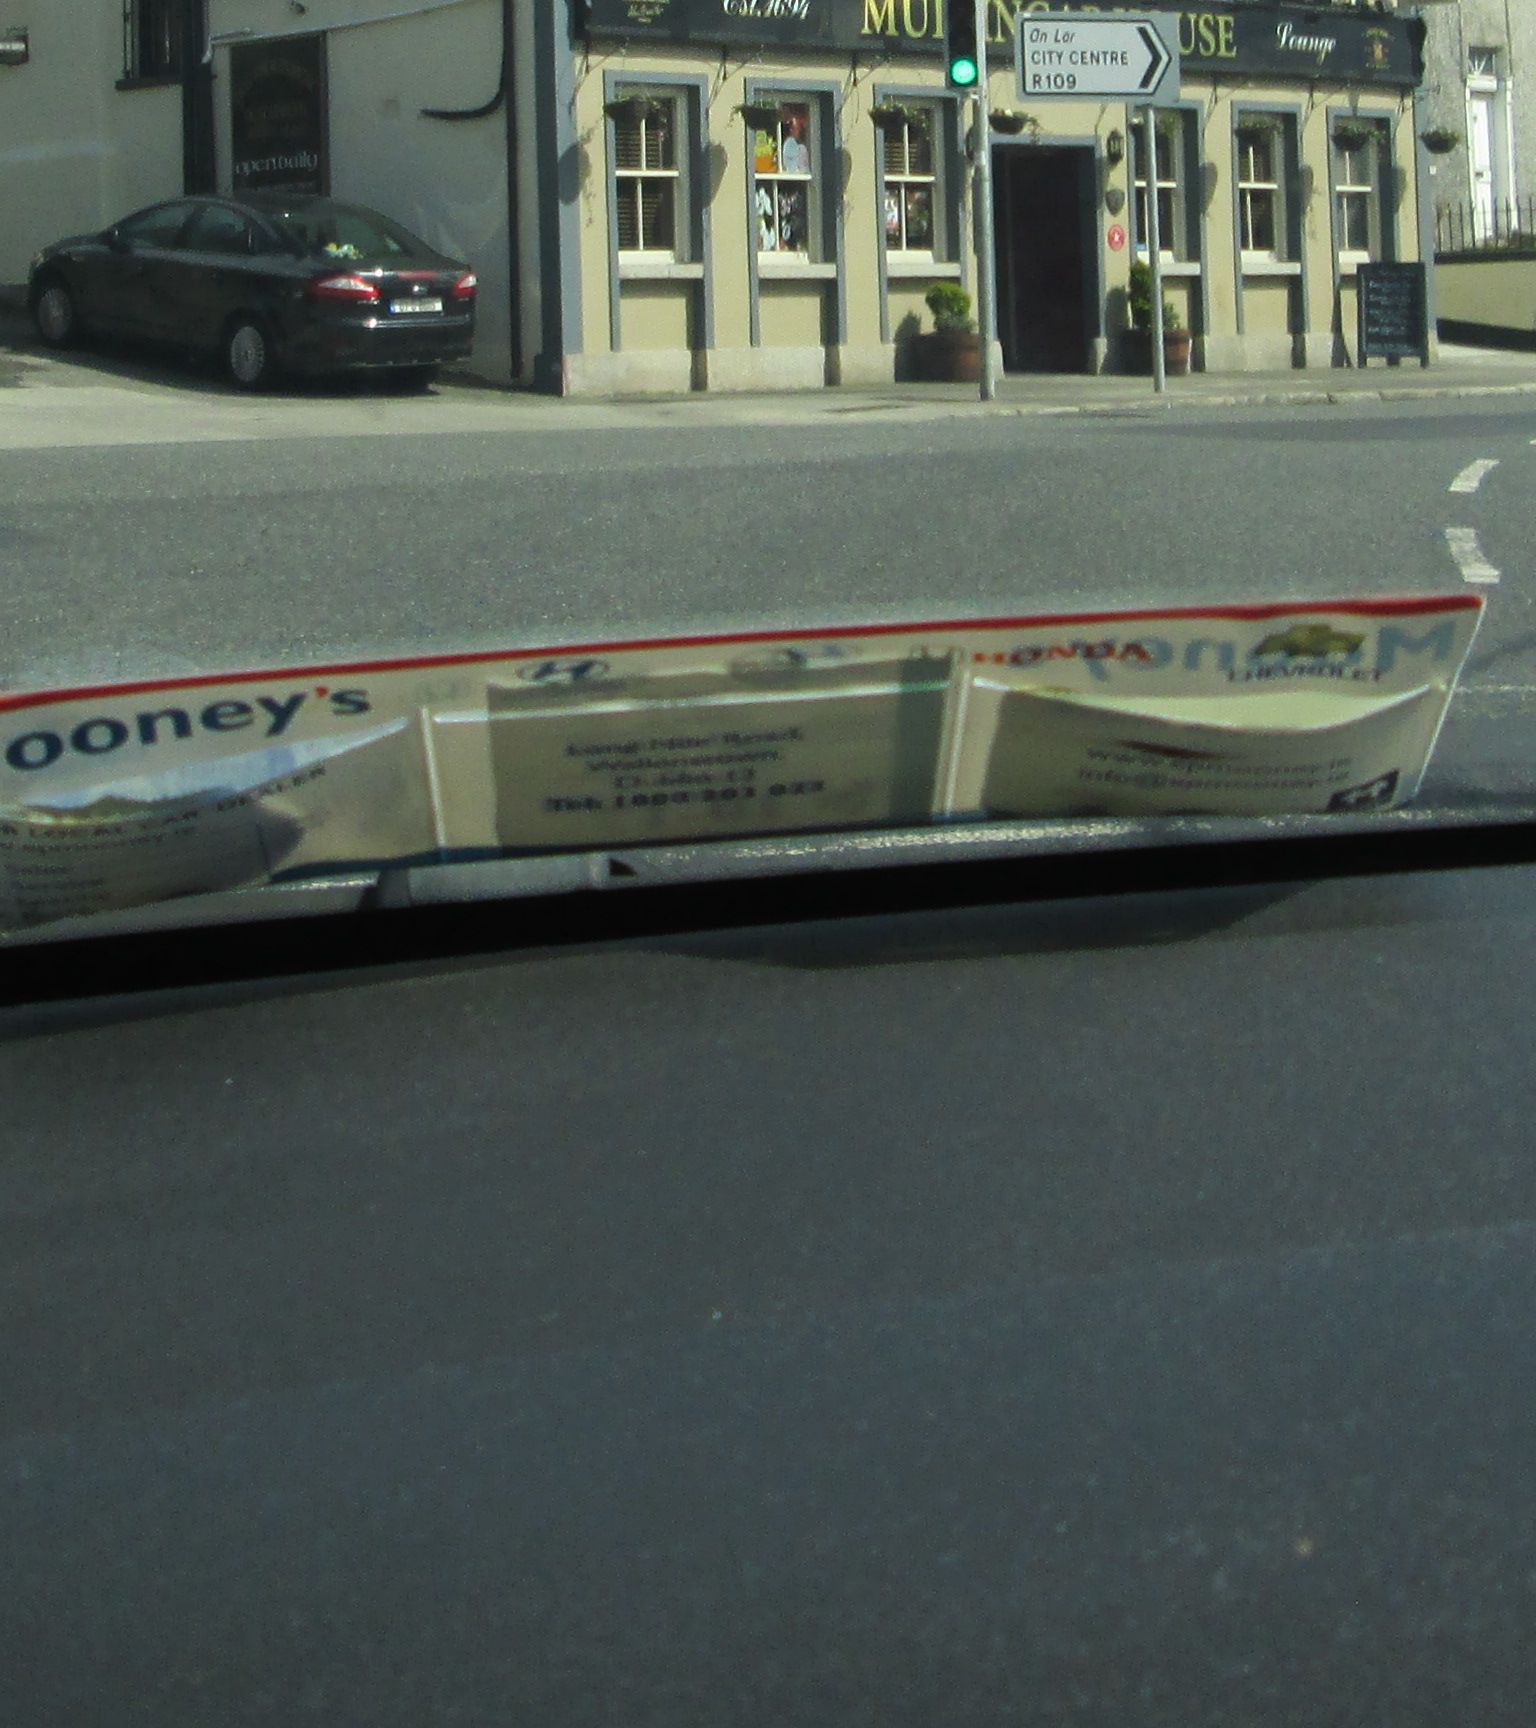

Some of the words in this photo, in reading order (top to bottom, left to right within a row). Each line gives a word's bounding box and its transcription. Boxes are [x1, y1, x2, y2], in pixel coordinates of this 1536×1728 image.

[1031, 50, 1063, 65] CITY
[1069, 50, 1129, 65] CENTRE
[1276, 21, 1337, 65] Lounge
